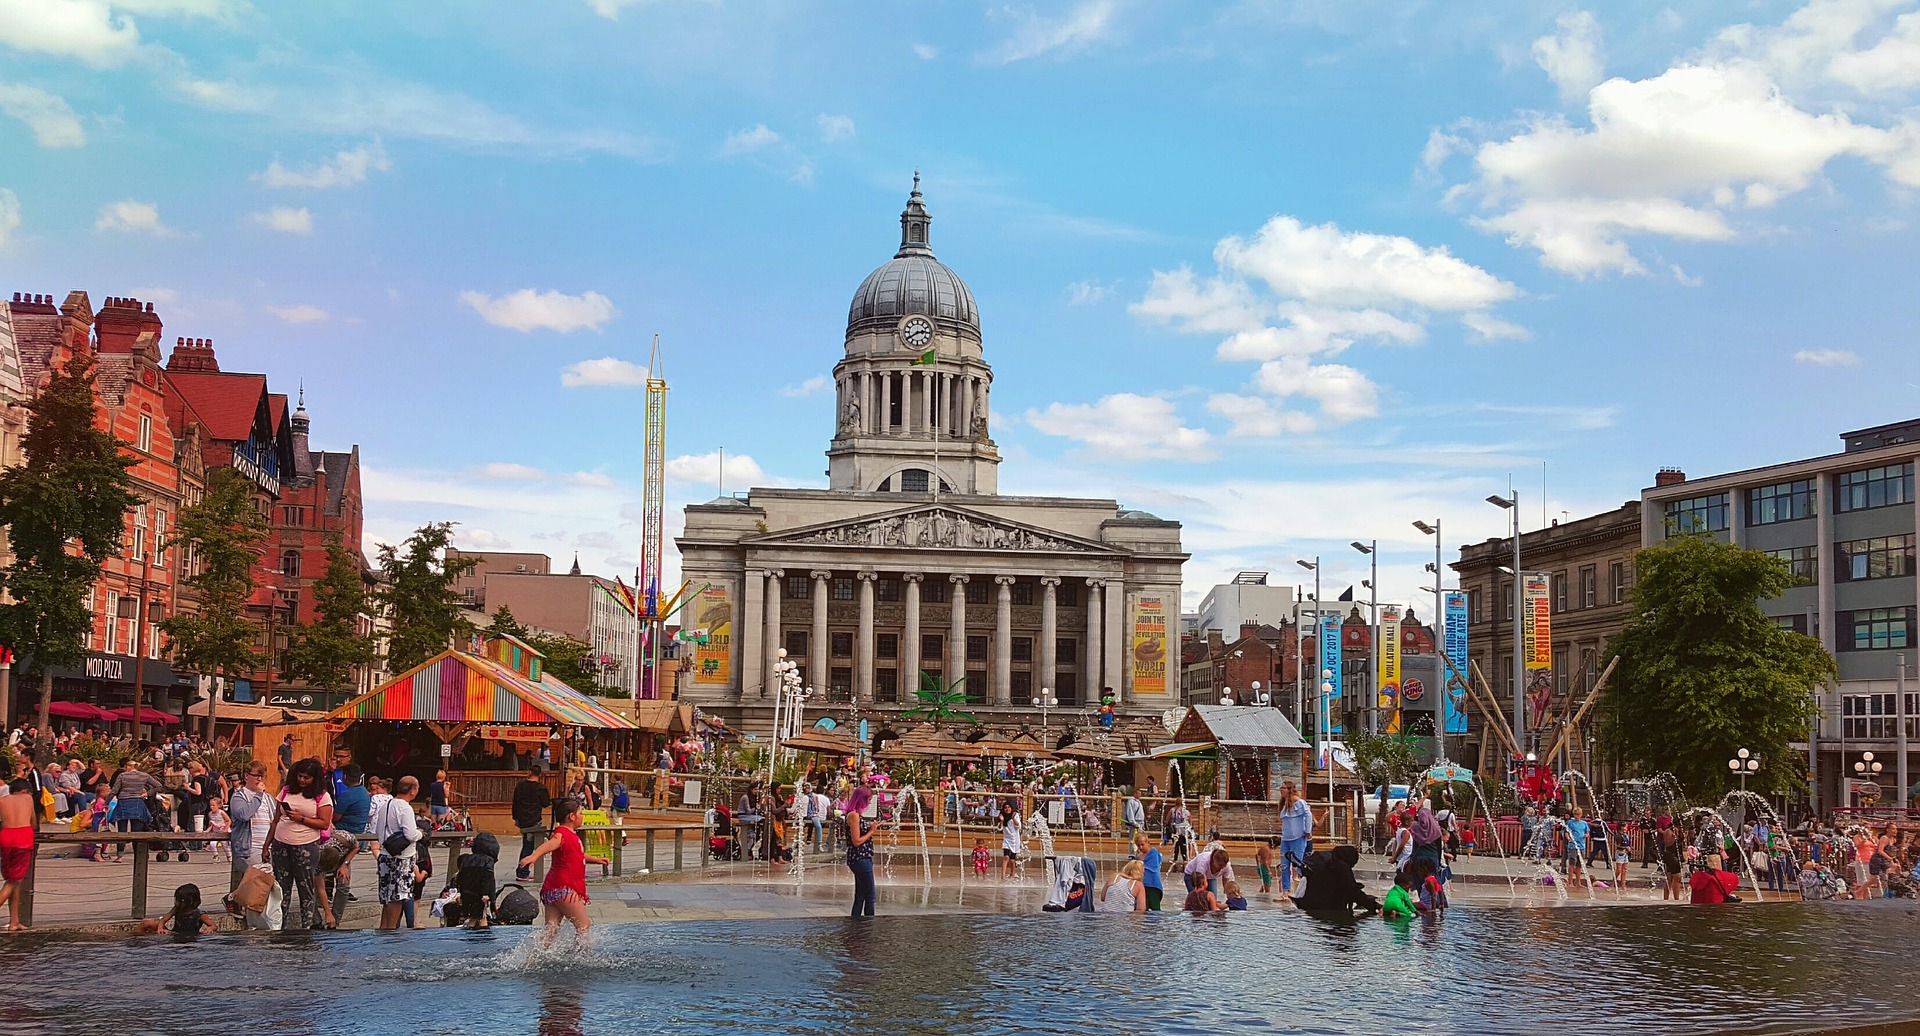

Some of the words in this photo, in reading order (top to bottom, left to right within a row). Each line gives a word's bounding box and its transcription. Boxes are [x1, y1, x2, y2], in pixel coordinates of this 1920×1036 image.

[1136, 616, 1152, 624] JOIN
[1153, 616, 1166, 624] THE
[1525, 597, 1535, 635] EXCLUSIVE
[1135, 623, 1166, 632] DINOSAUR
[1457, 613, 1467, 635] ARTS
[1535, 598, 1550, 662] EXHIBITION
[1135, 631, 1166, 639] REVOLUTION
[1386, 625, 1395, 641] HALL
[1326, 633, 1337, 650] 2017
[1457, 635, 1467, 671] LAKESIDE
[1526, 636, 1535, 663] WORLD
[1327, 651, 1337, 665] OCT
[1386, 641, 1395, 678] WOLLATON
[86, 657, 101, 678] MOD
[103, 659, 123, 680] PIZZA
[1135, 660, 1166, 672] WORLD
[1135, 671, 1166, 679] EXCLUSIVE
[1403, 681, 1422, 691] BURGER
[1404, 685, 1423, 697] KING
[270, 695, 298, 704] Clarks
